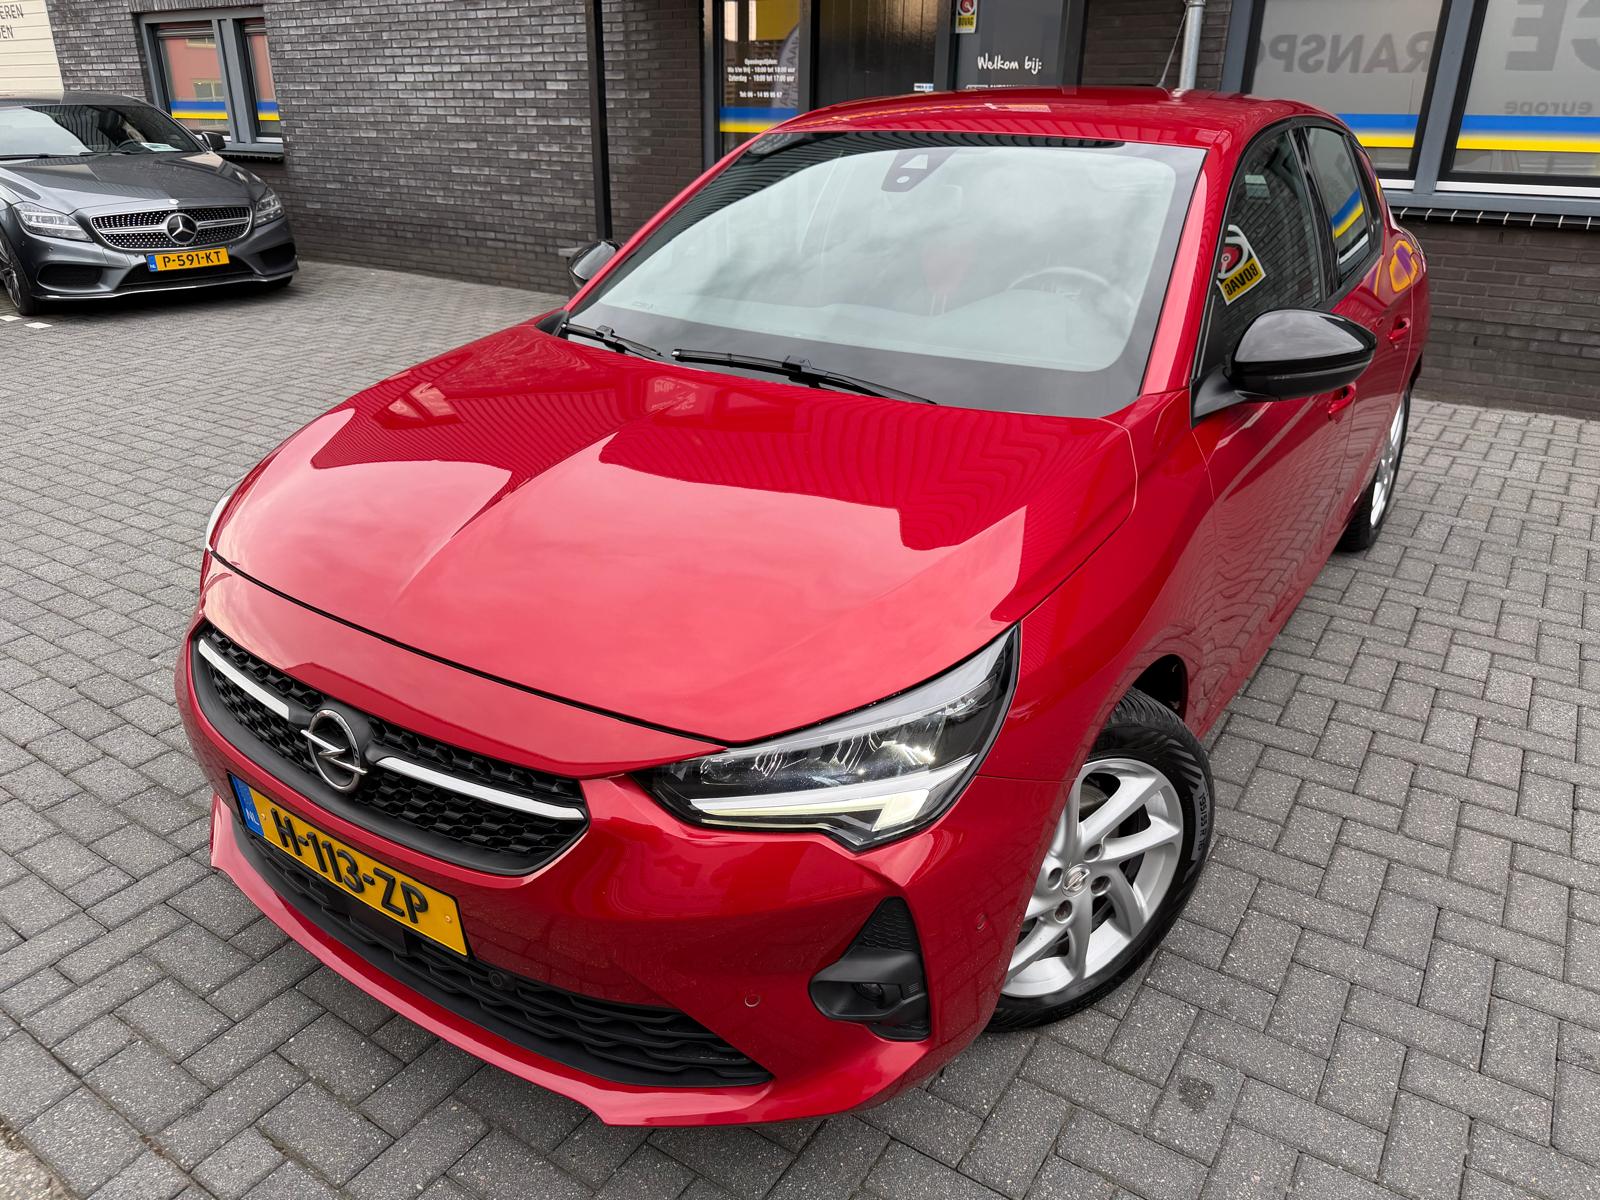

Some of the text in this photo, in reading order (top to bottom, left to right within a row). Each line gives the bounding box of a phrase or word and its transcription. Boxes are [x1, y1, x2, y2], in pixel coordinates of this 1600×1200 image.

[0, 25, 14, 39] EN
[977, 52, 1042, 75] Welkom bij:
[162, 251, 221, 268] P-591-KT
[245, 807, 260, 826] NL
[270, 807, 429, 924] H-113-ZP
